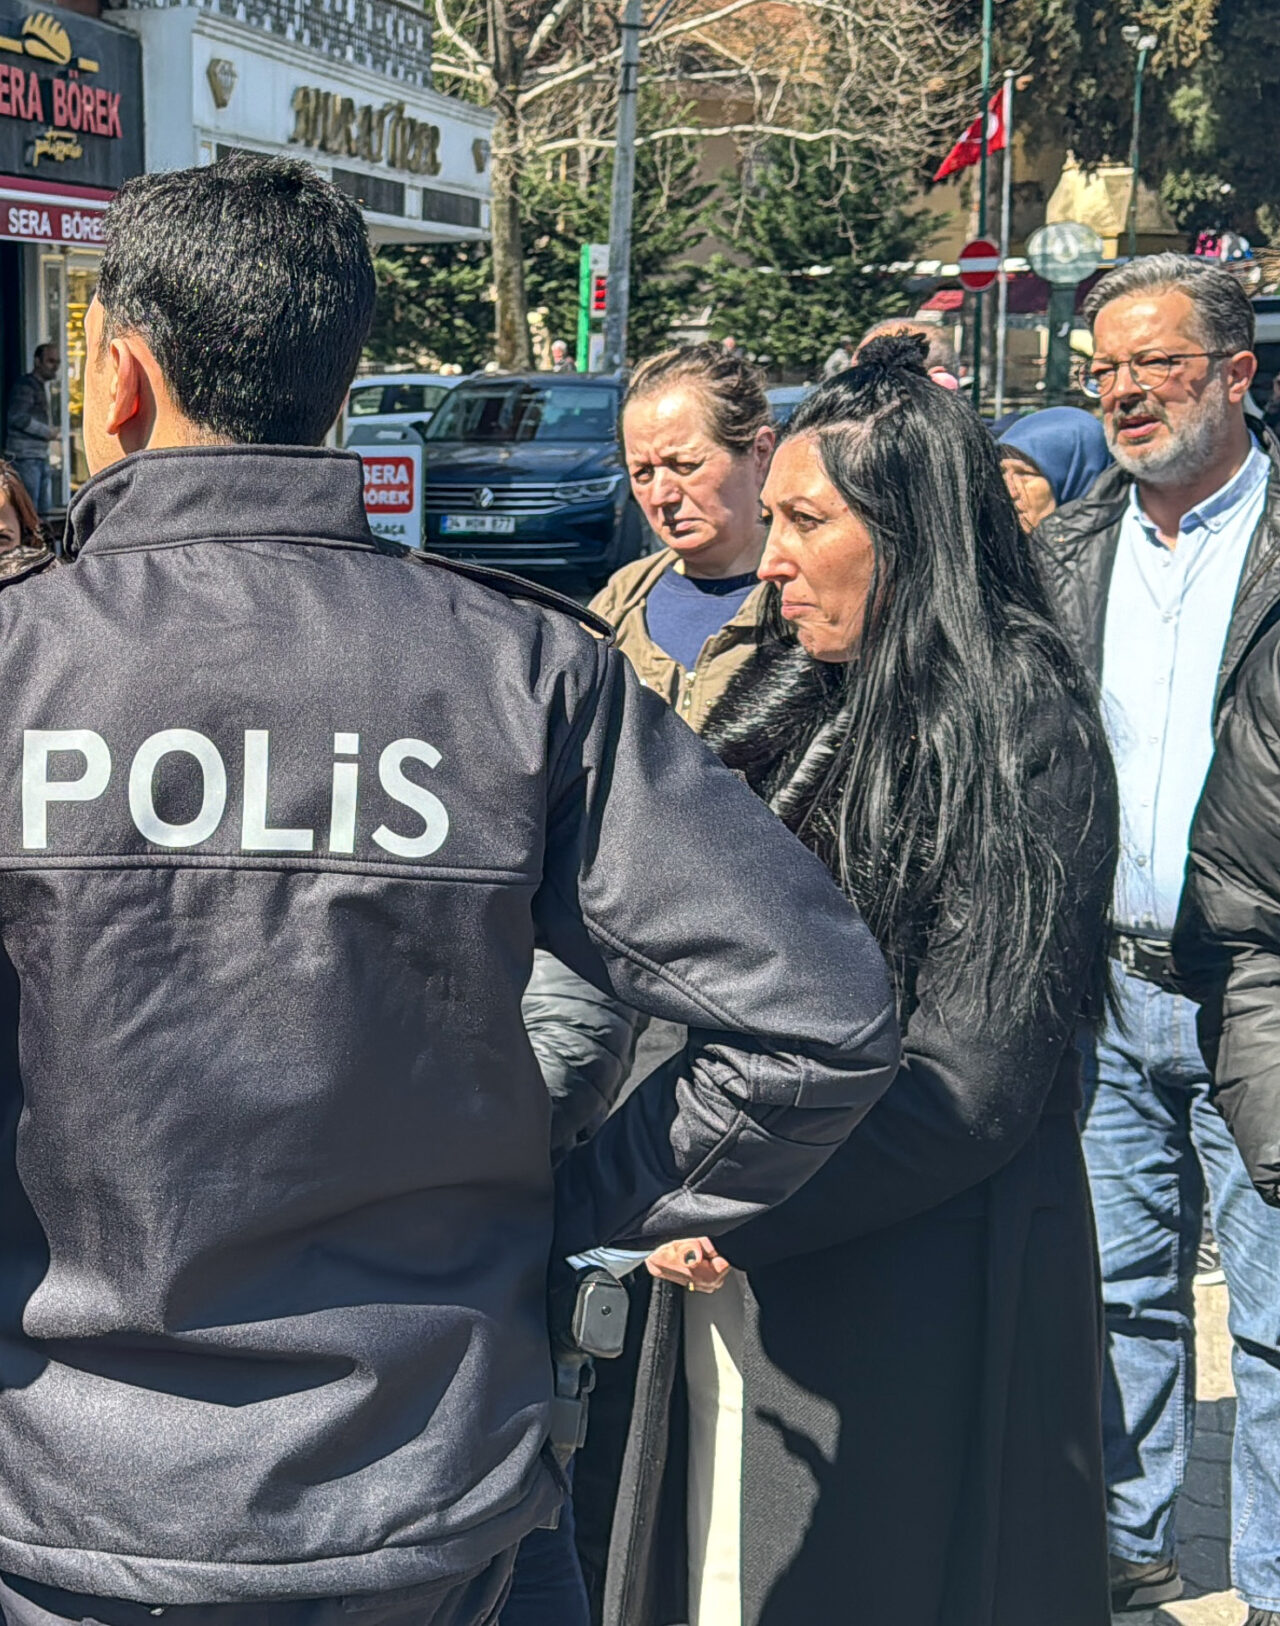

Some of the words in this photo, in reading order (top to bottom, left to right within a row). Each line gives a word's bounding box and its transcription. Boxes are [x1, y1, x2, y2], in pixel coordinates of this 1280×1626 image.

[52, 69, 123, 138] BÖREK
[7, 207, 52, 237] SERA
[61, 211, 105, 241] BÖRE
[363, 488, 410, 506] ÖREK
